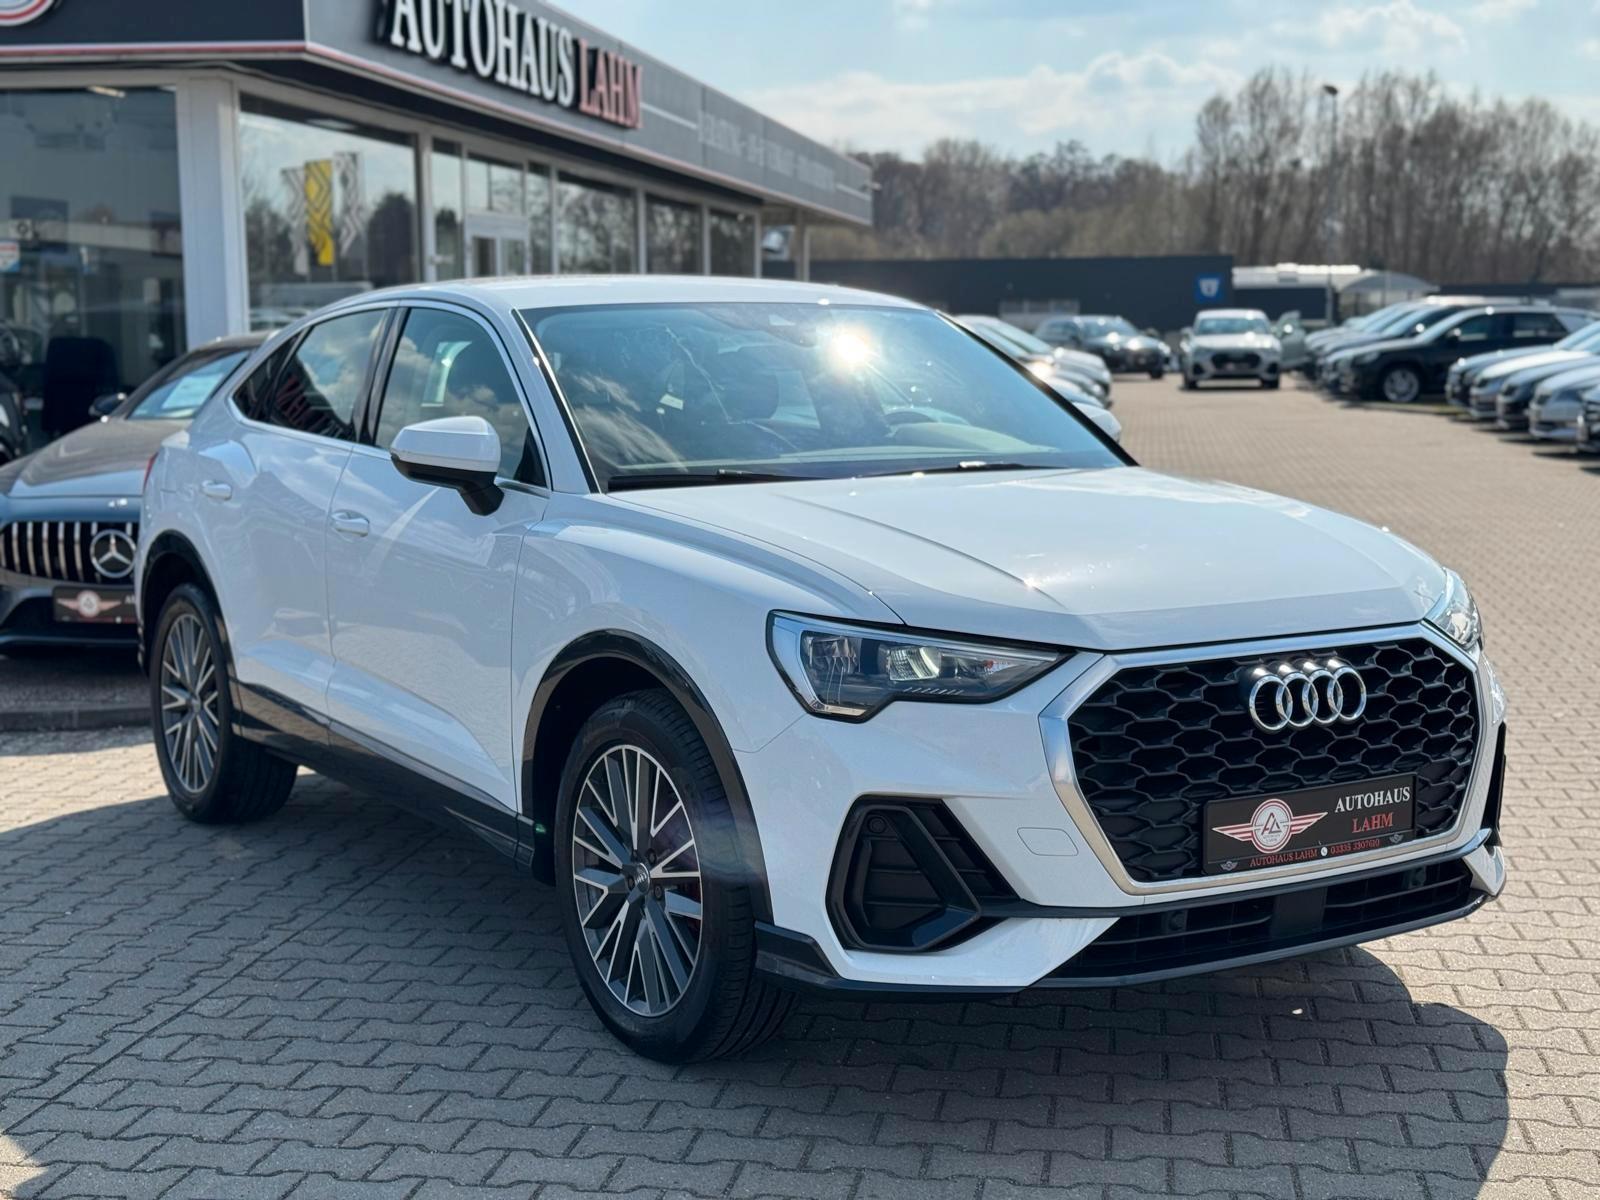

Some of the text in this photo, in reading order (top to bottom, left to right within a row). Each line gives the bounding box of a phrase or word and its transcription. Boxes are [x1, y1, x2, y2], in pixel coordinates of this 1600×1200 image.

[391, 0, 643, 129] AUTOHAUS LAHM
[1334, 786, 1411, 813] AUTOHAUS
[1351, 812, 1394, 834] LAHM
[1249, 853, 1294, 868] AUTOHAUS
[1295, 848, 1318, 860] LAHM
